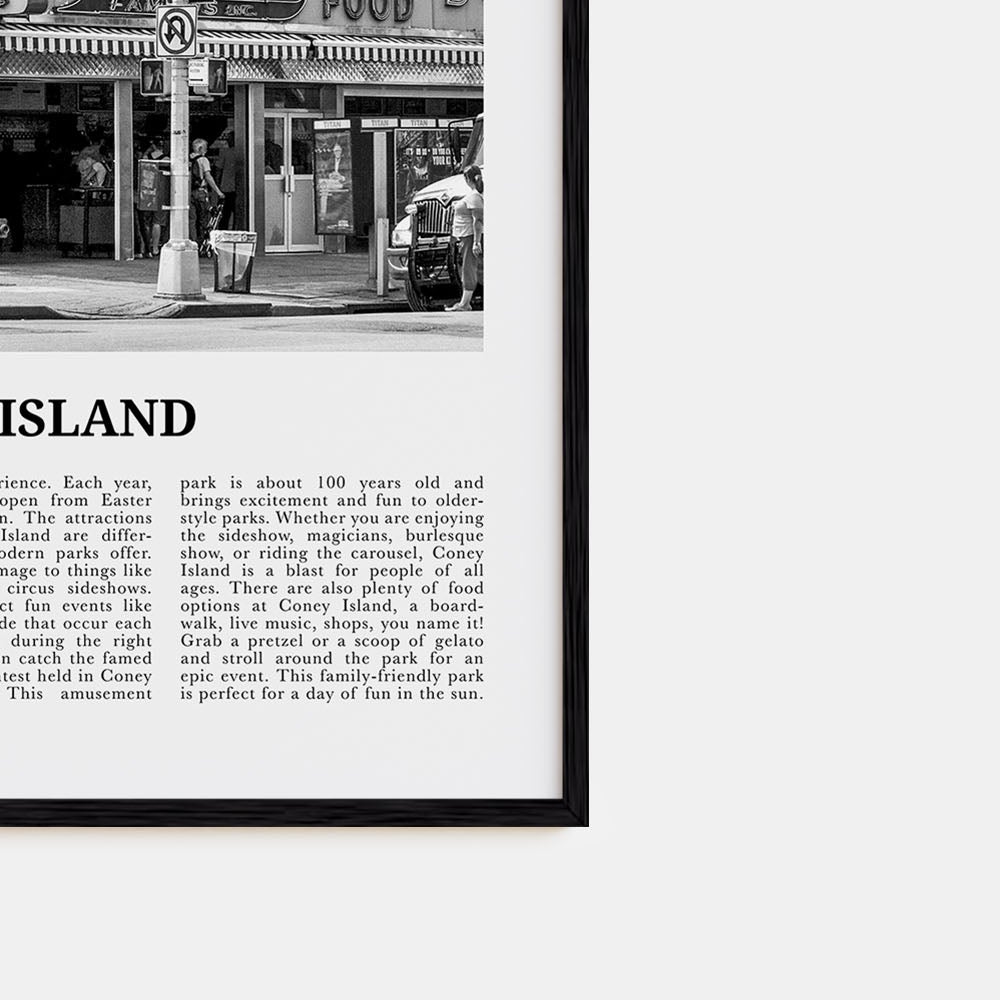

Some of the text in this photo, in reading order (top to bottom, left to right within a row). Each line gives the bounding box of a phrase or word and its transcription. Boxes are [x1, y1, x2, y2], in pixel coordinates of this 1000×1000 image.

[63, 475, 103, 490] Each
[113, 480, 152, 493] year,
[180, 475, 484, 493] park is about 100 years old and
[22, 510, 56, 525] The
[65, 510, 153, 525] attractions
[180, 528, 484, 546] the sideshow, magicians, burlesque
[44, 565, 60, 577] to
[67, 563, 117, 581] things
[123, 563, 152, 577] like
[24, 616, 56, 630] that
[62, 620, 109, 630] occur
[115, 616, 152, 630] each
[37, 669, 72, 683] held
[78, 669, 94, 683] in
[100, 669, 153, 687] Coney
[180, 669, 484, 687] epic event. This family-friendly park
